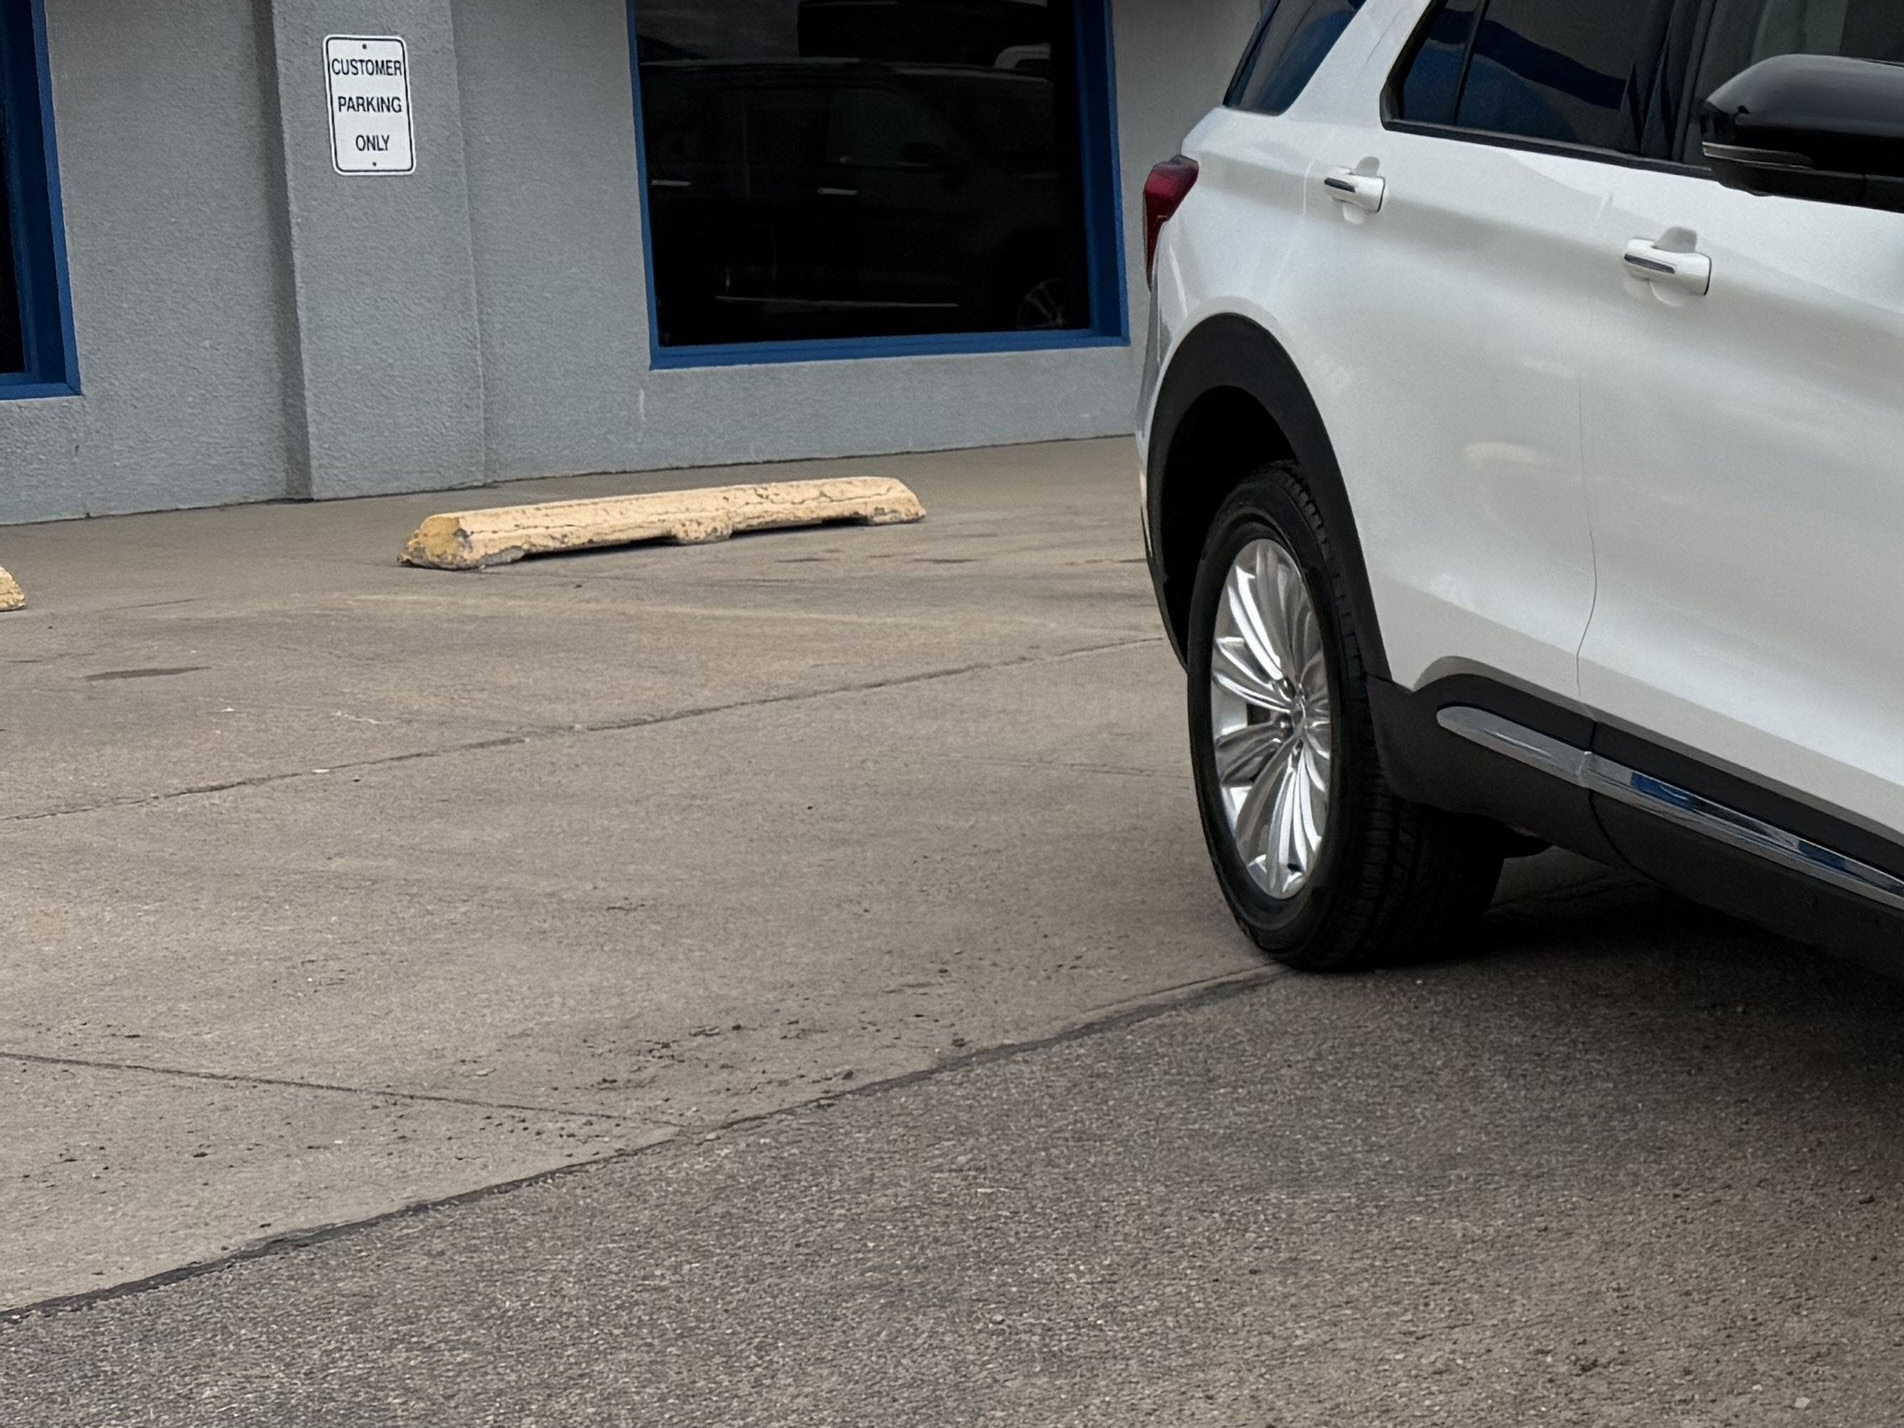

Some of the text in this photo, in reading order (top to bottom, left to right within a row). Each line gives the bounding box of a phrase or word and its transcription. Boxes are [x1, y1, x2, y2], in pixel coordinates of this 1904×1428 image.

[331, 58, 402, 77] CUSTOMER
[338, 95, 402, 113] PARKING
[355, 134, 390, 152] ONLY
